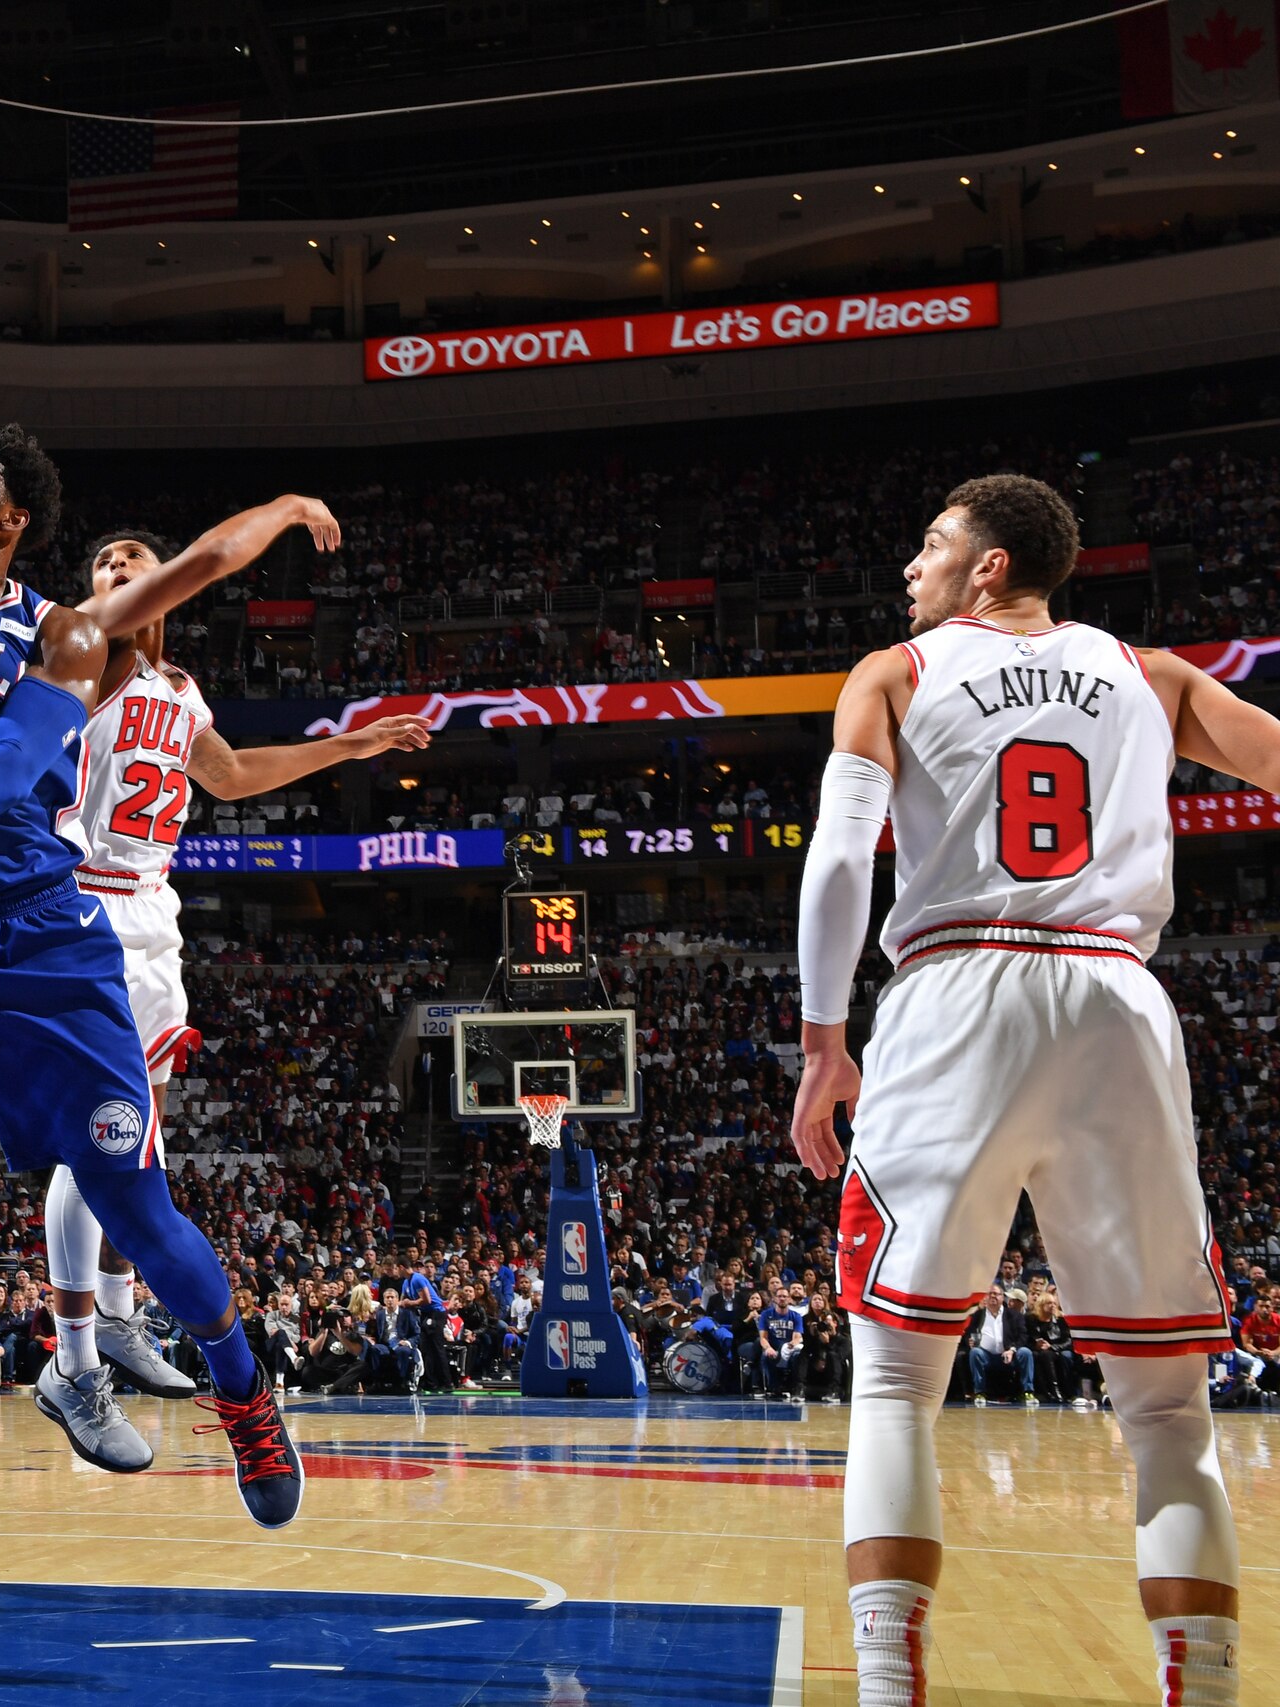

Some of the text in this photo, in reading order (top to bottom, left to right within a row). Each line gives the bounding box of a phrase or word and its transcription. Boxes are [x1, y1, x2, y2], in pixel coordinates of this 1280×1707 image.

[438, 295, 972, 368] TOYOTA Let's Go Places
[959, 666, 1115, 719] LAVINE
[112, 696, 196, 766] BULL
[109, 760, 183, 846] 22
[996, 737, 1095, 883] 8
[290, 838, 302, 852] 1
[625, 827, 694, 854] 7:25
[716, 834, 729, 852] 1
[764, 823, 802, 849] 15
[358, 831, 460, 872] PHILA
[579, 838, 609, 857] 14
[290, 854, 303, 869] 7
[530, 897, 577, 920] 7:25
[535, 922, 572, 955] 14
[531, 962, 583, 974] TISSOT
[422, 1022, 448, 1034] 120
[95, 1121, 138, 1141] 76ers
[562, 1284, 590, 1301] @NBA
[572, 1321, 591, 1338] NBA
[775, 1330, 787, 1338] 21
[573, 1338, 607, 1356] League
[573, 1355, 597, 1369] Pass
